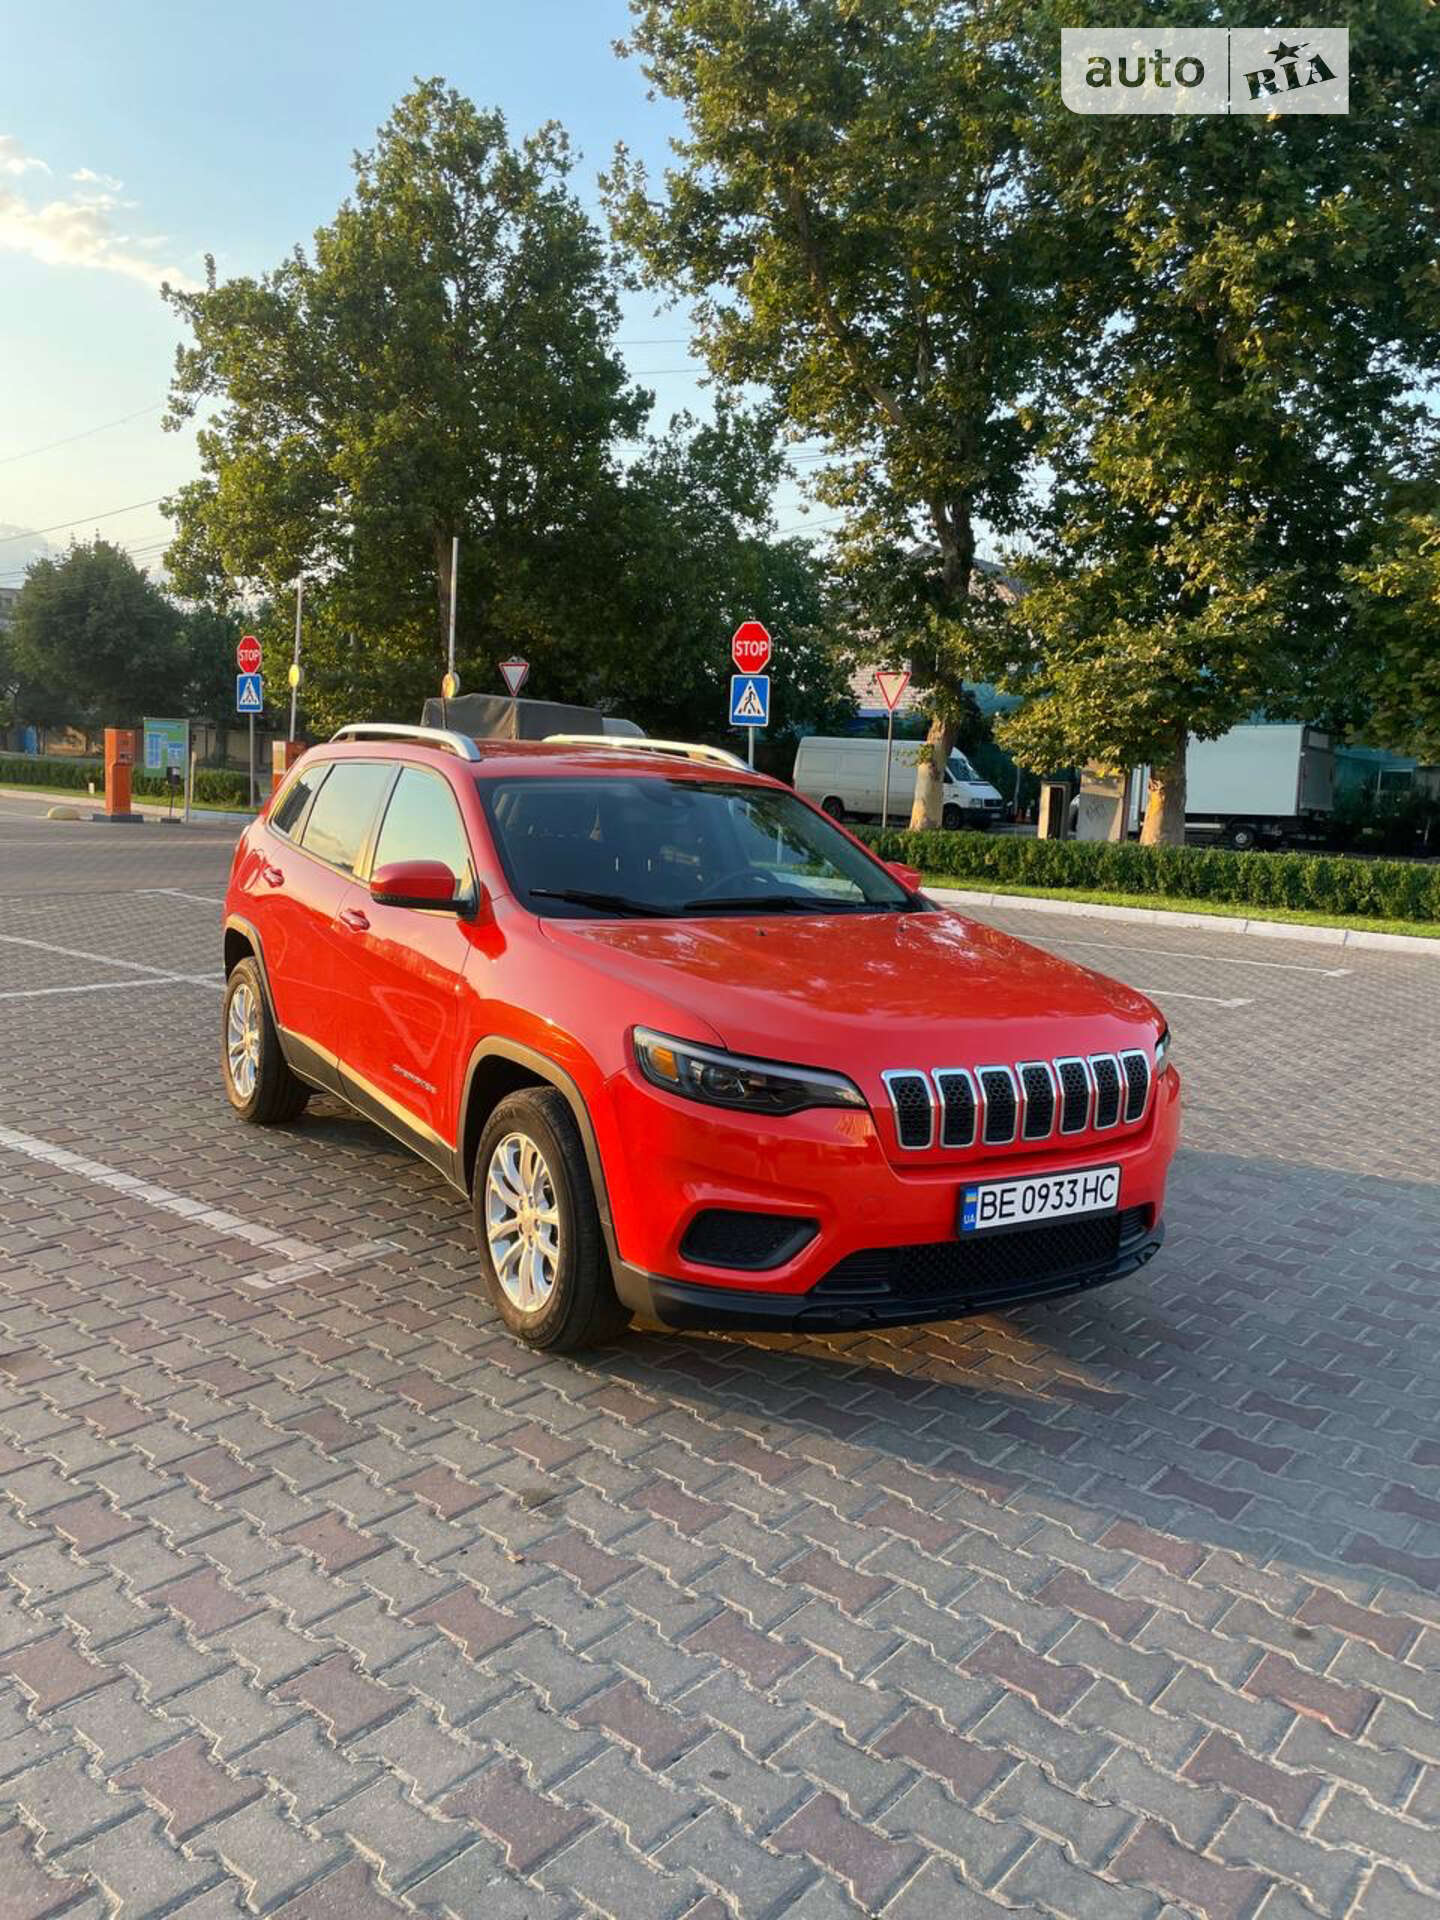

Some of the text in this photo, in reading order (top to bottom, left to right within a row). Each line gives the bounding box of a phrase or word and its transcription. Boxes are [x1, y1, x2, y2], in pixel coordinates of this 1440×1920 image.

[238, 649, 260, 661] STOP
[735, 640, 768, 656] STOP
[979, 1174, 1116, 1222] BE 0933 HC
